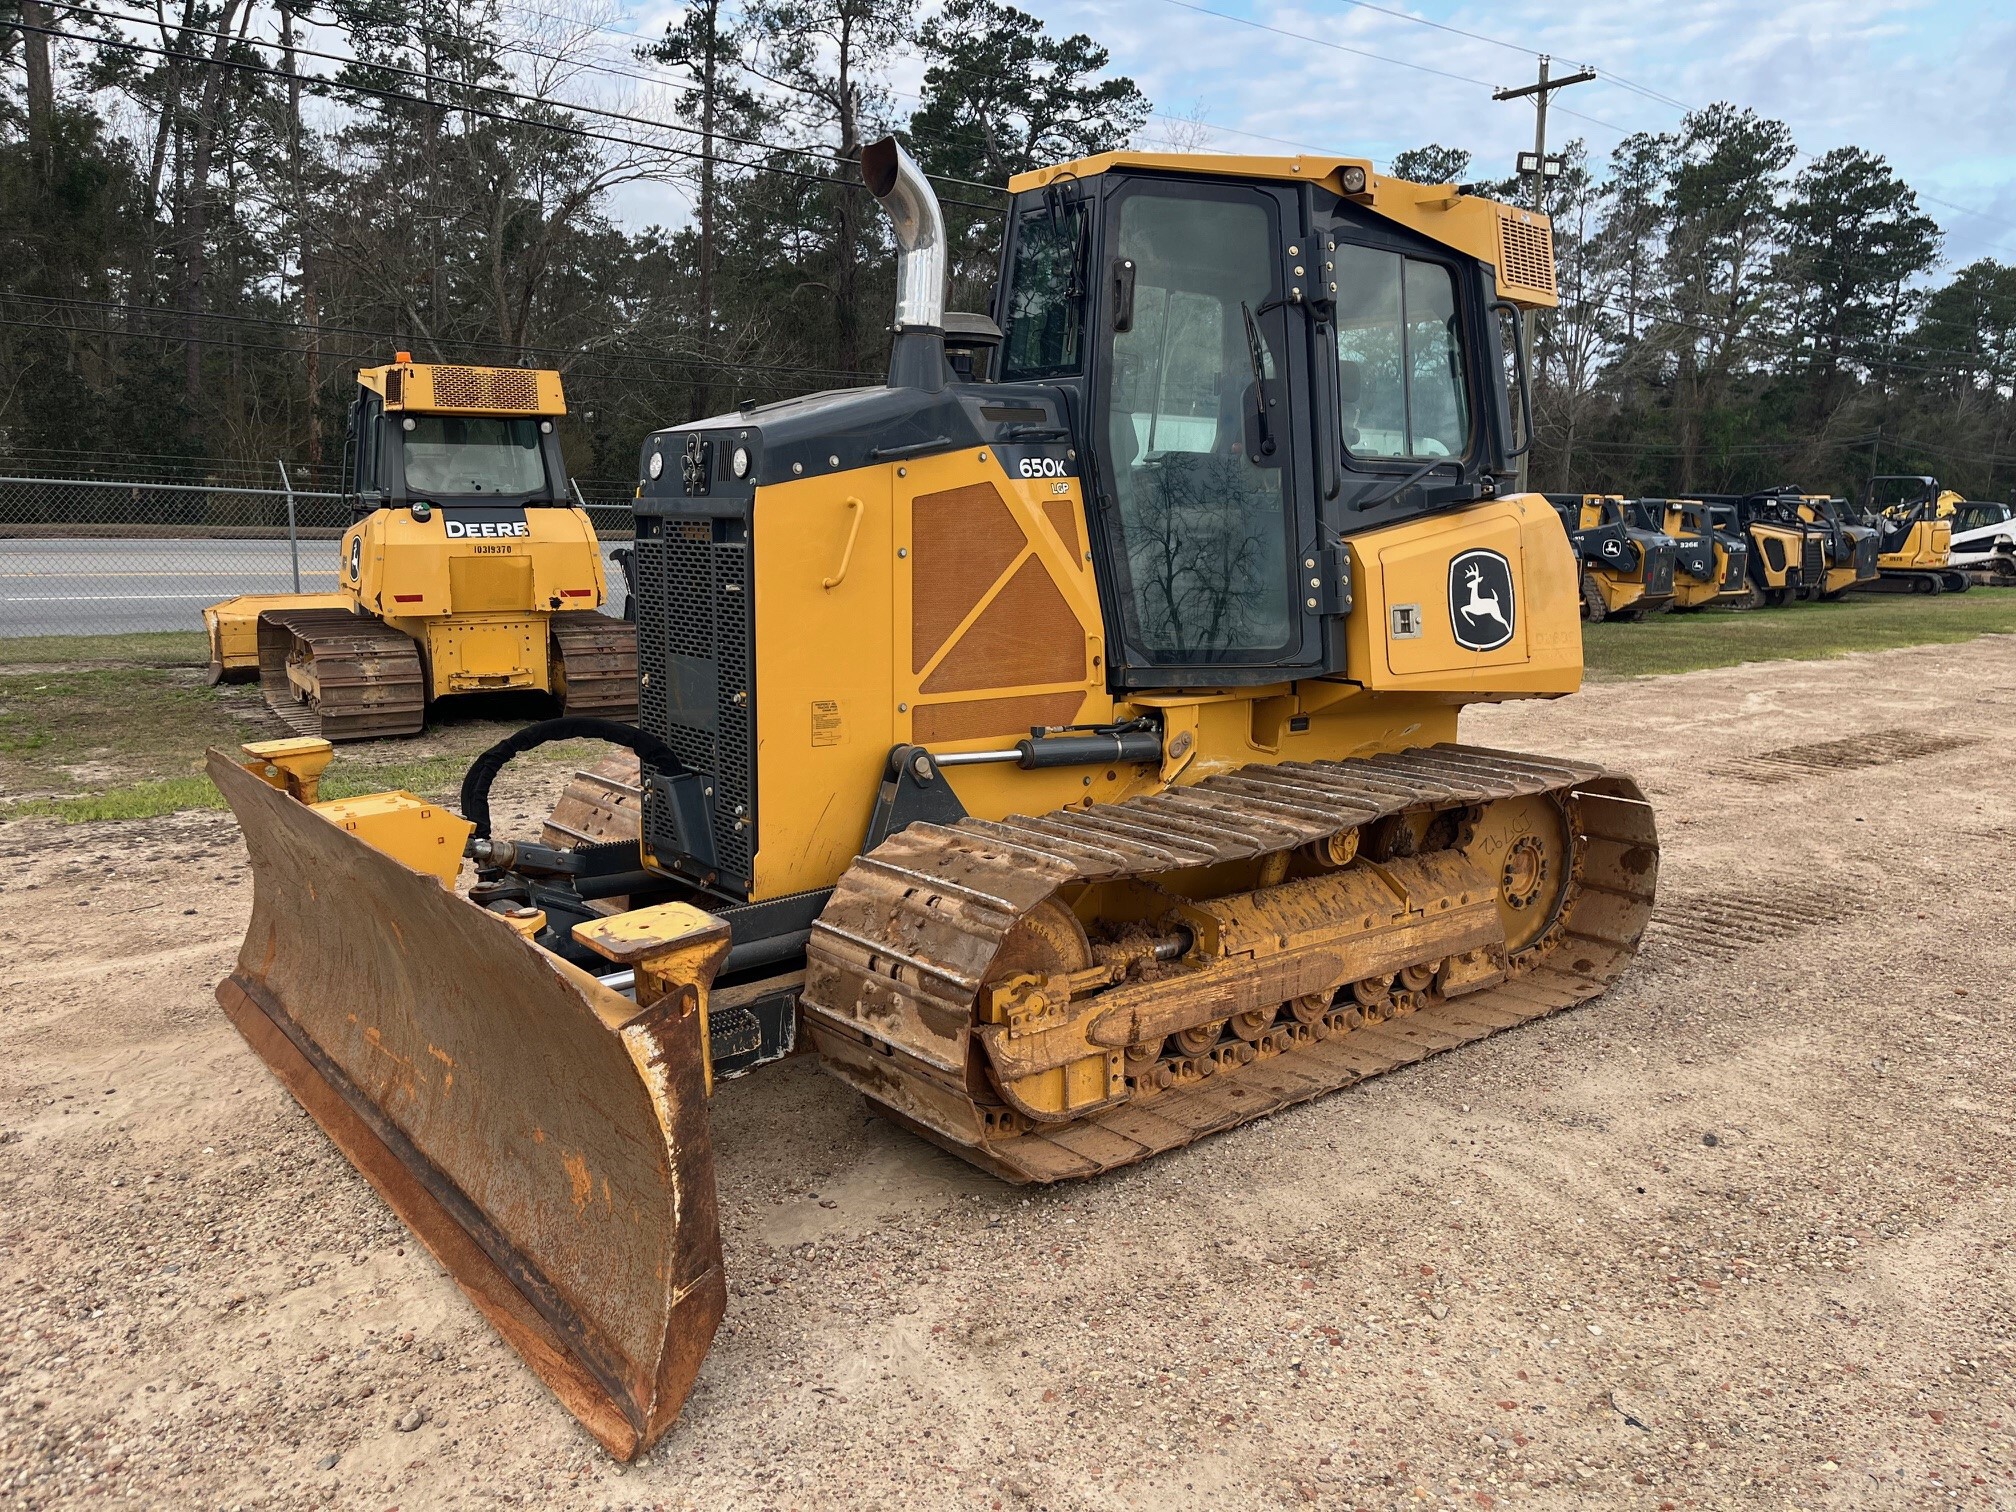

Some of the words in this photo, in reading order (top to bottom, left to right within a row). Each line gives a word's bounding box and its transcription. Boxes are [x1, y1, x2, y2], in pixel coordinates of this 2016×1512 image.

[1019, 458, 1067, 477] 650K
[1051, 483, 1069, 494] LGP
[445, 521, 529, 537] DEERE
[474, 545, 512, 554] 10319370
